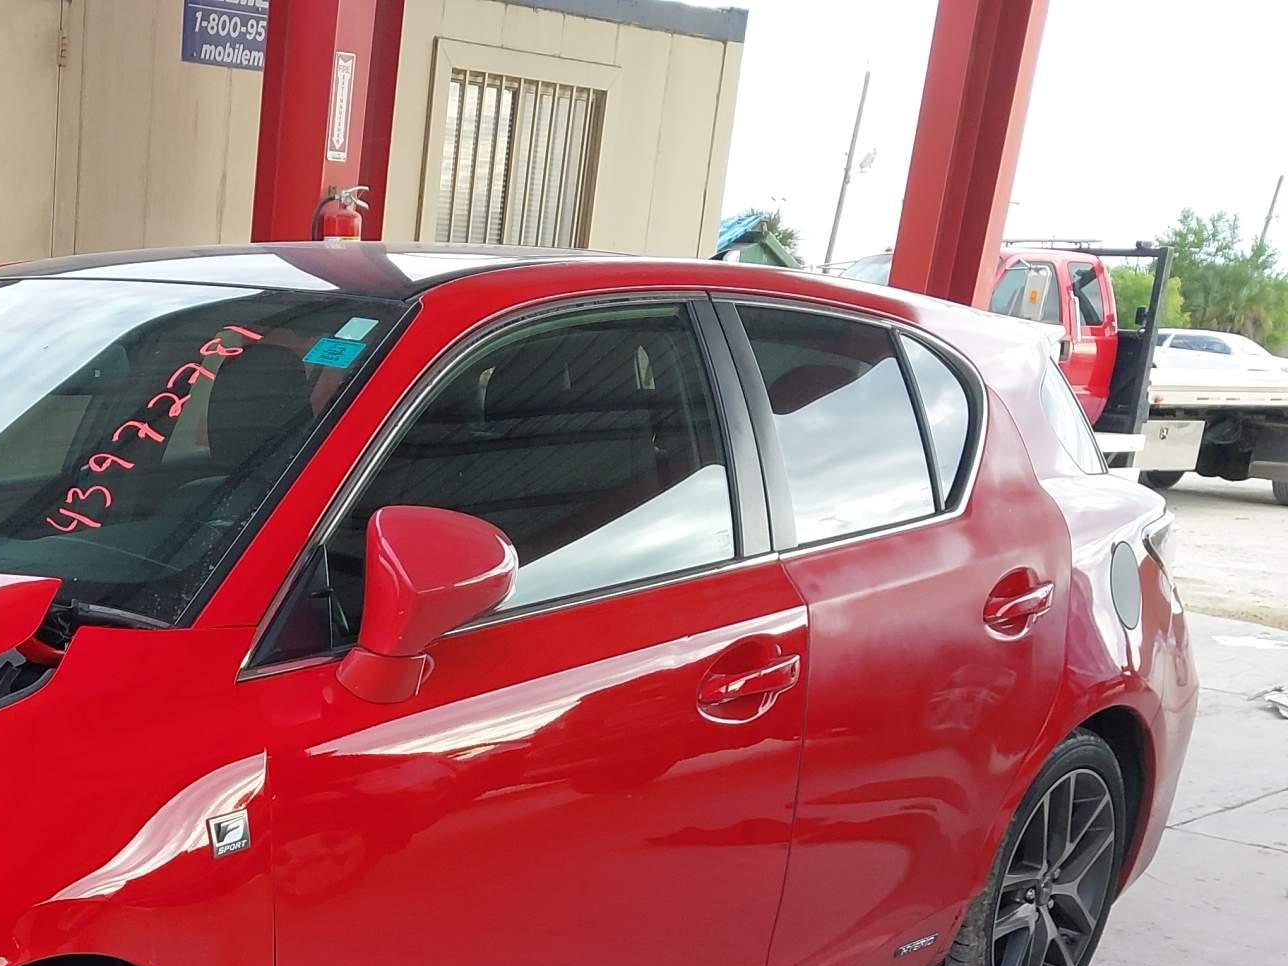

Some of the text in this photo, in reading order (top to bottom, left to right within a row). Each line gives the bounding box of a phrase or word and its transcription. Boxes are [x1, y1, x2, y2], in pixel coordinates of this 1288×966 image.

[194, 11, 267, 41] 1-800-95
[46, 324, 264, 532] 43972781
[217, 839, 248, 855] SPORT
